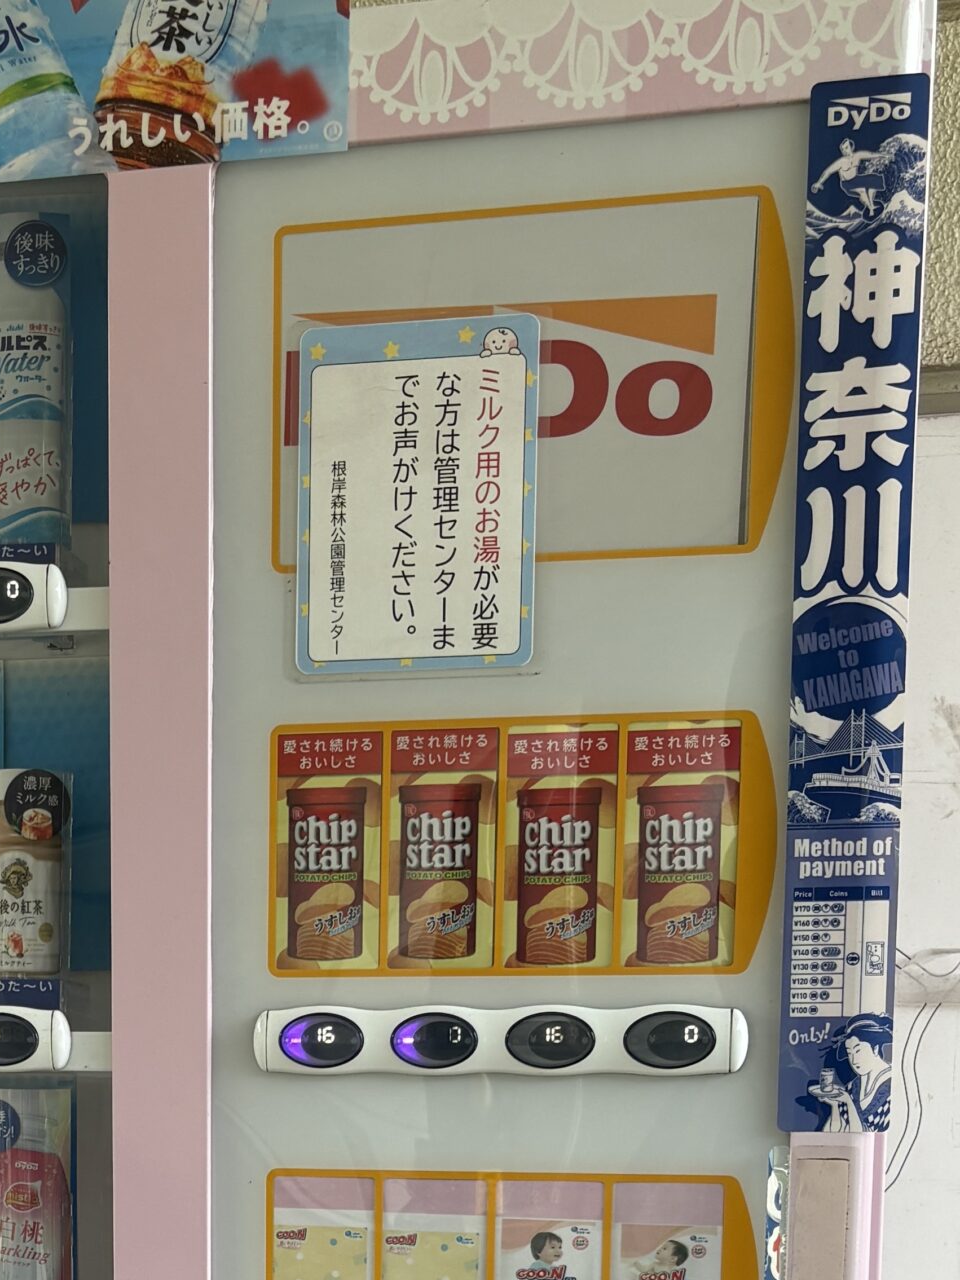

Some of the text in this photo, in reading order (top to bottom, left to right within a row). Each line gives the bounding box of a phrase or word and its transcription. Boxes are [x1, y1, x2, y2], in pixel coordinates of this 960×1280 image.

[827, 91, 912, 131] DyDo
[68, 97, 310, 156] うれしい価格。
[14, 231, 54, 251] 後味
[13, 253, 61, 275] すっきり
[799, 230, 920, 591] 神奈川
[390, 372, 421, 638] でお声がけください。
[432, 371, 462, 650] な方は管理センターま
[471, 368, 503, 650] ミルク用のお湯が必要
[330, 460, 347, 655] 根岸森林公園管理センター
[796, 620, 894, 655] Welcome
[803, 661, 903, 711] KANAGAWA
[283, 737, 373, 755] 愛され続ける
[635, 734, 731, 751] 愛され続ける
[299, 756, 357, 769] おいしさ
[651, 752, 713, 767] おいしさ
[24, 776, 51, 791] 濃厚
[295, 812, 357, 845] chip
[406, 810, 471, 843] chip
[525, 814, 591, 848] chip
[646, 812, 713, 845] chip
[295, 842, 357, 872] star
[406, 841, 471, 869] star
[524, 845, 591, 874] star
[645, 842, 713, 872] star
[794, 837, 893, 857] Method of
[799, 857, 885, 879] payment
[789, 1023, 830, 1045] Only!
